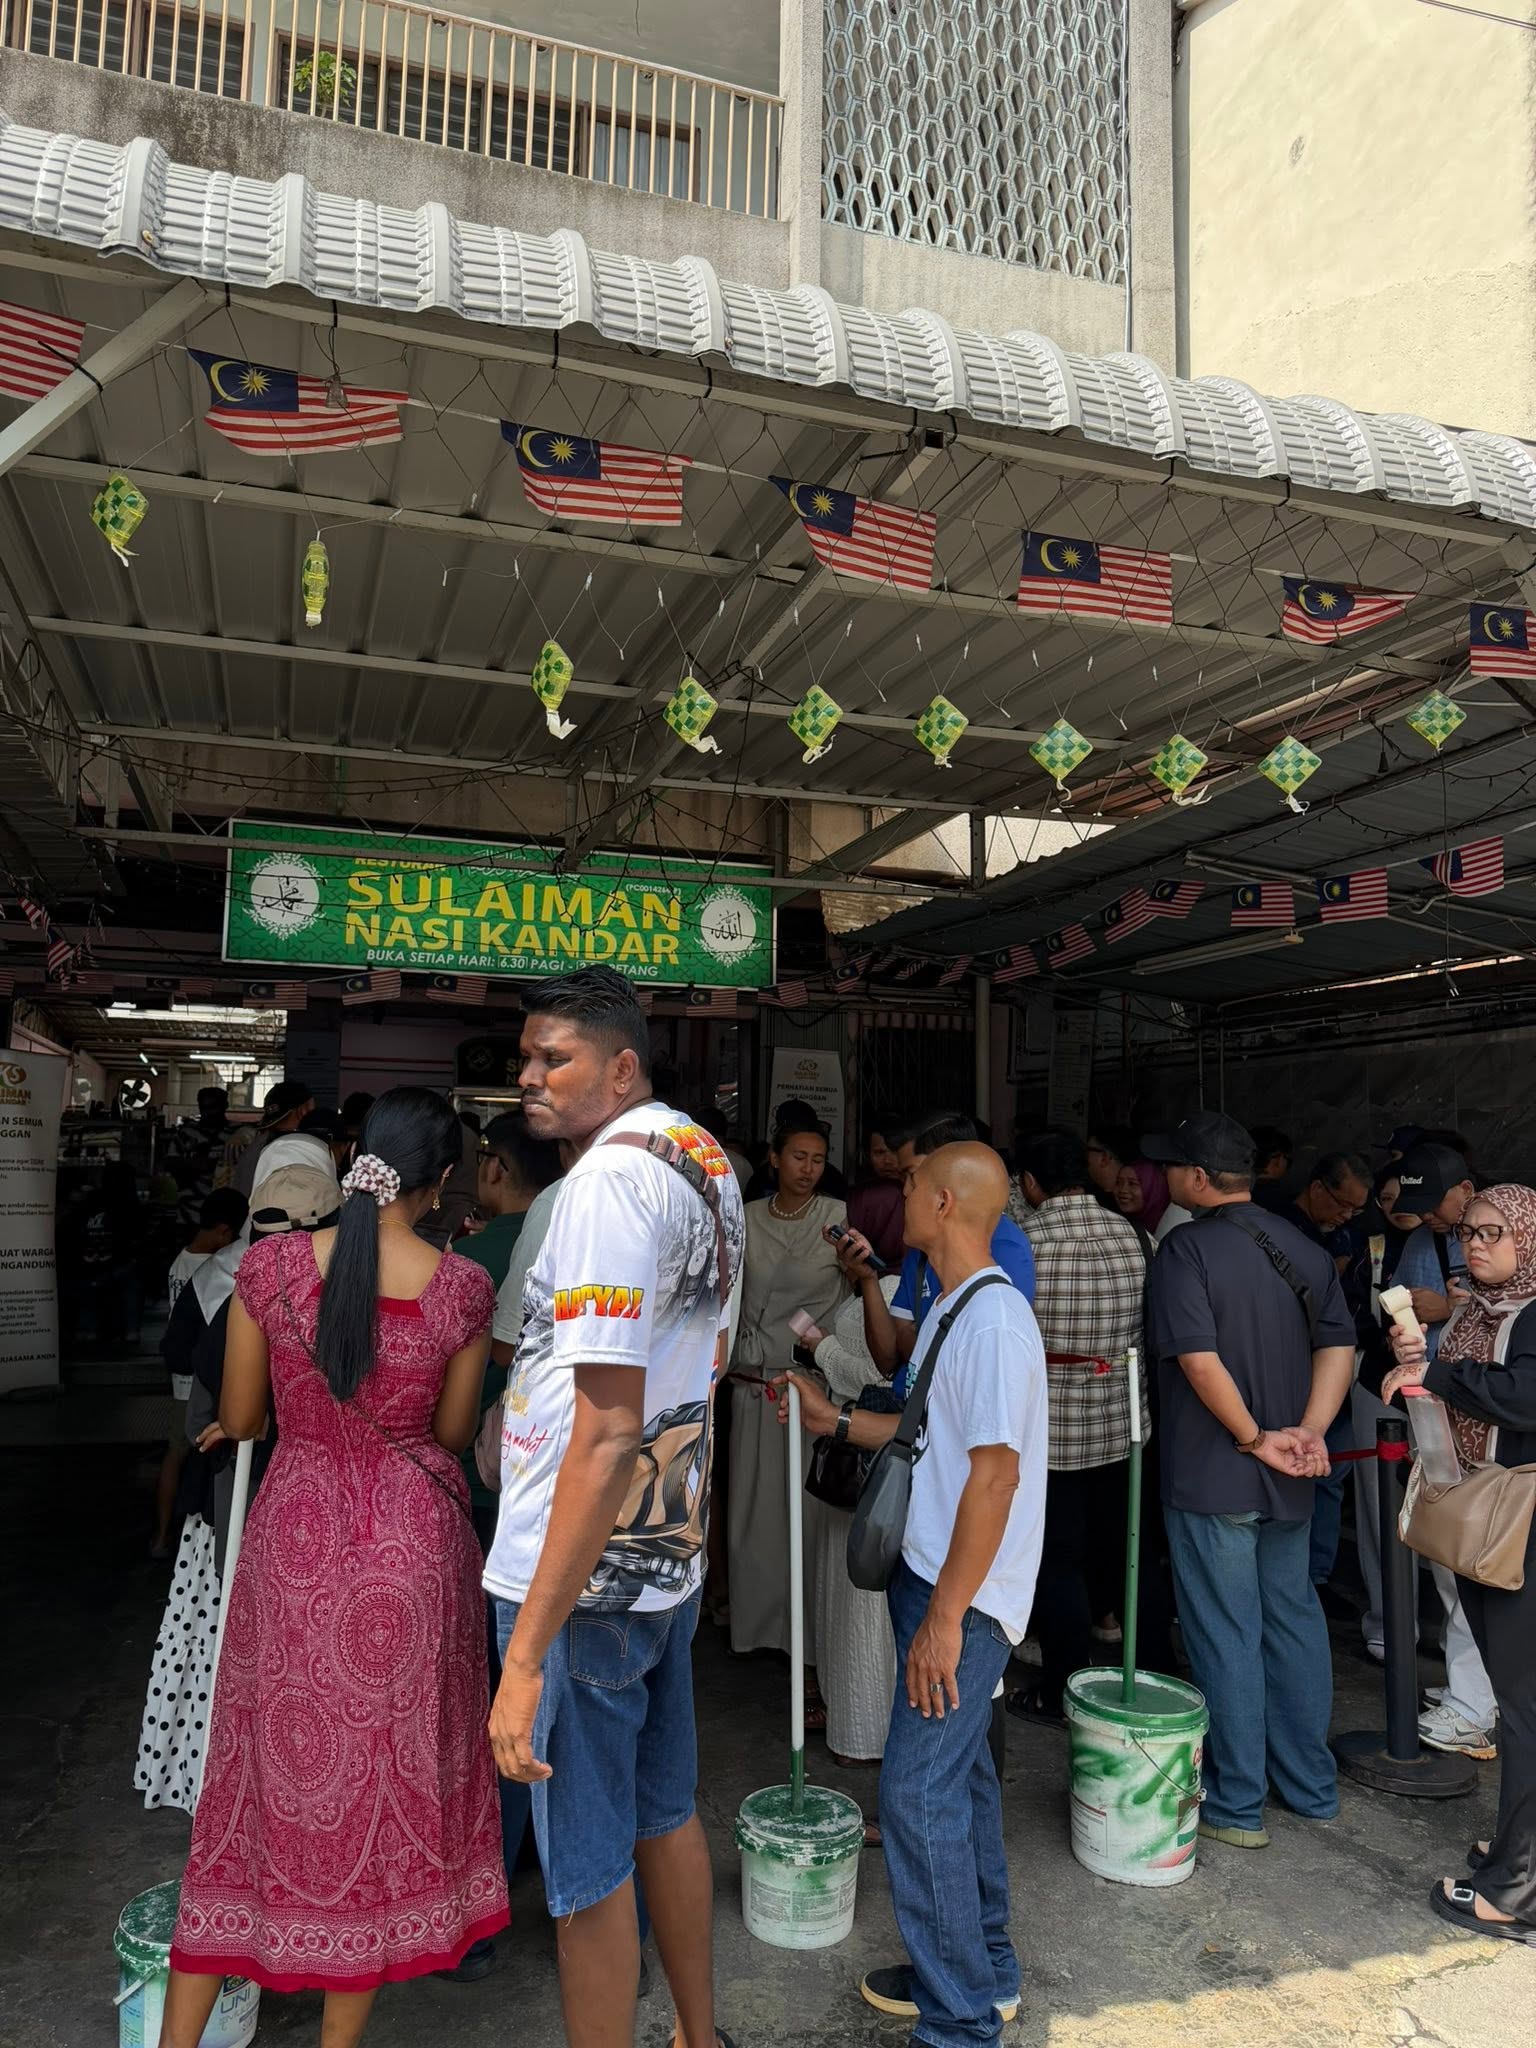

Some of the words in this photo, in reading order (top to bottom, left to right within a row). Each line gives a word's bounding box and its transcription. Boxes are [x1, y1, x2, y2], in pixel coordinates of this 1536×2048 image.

[347, 870, 682, 932] SULAIMAN
[345, 912, 465, 952] NASI
[480, 920, 680, 965] KANDAR
[366, 949, 405, 962] BUKA
[410, 951, 455, 965] SETIAP
[458, 954, 496, 967] HARI:
[499, 957, 526, 969] 6.30
[530, 959, 564, 971] PAGI
[12, 1116, 43, 1127] SEMUA
[21, 1248, 54, 1257] WARGA
[220, 1986, 251, 2014] UNI
